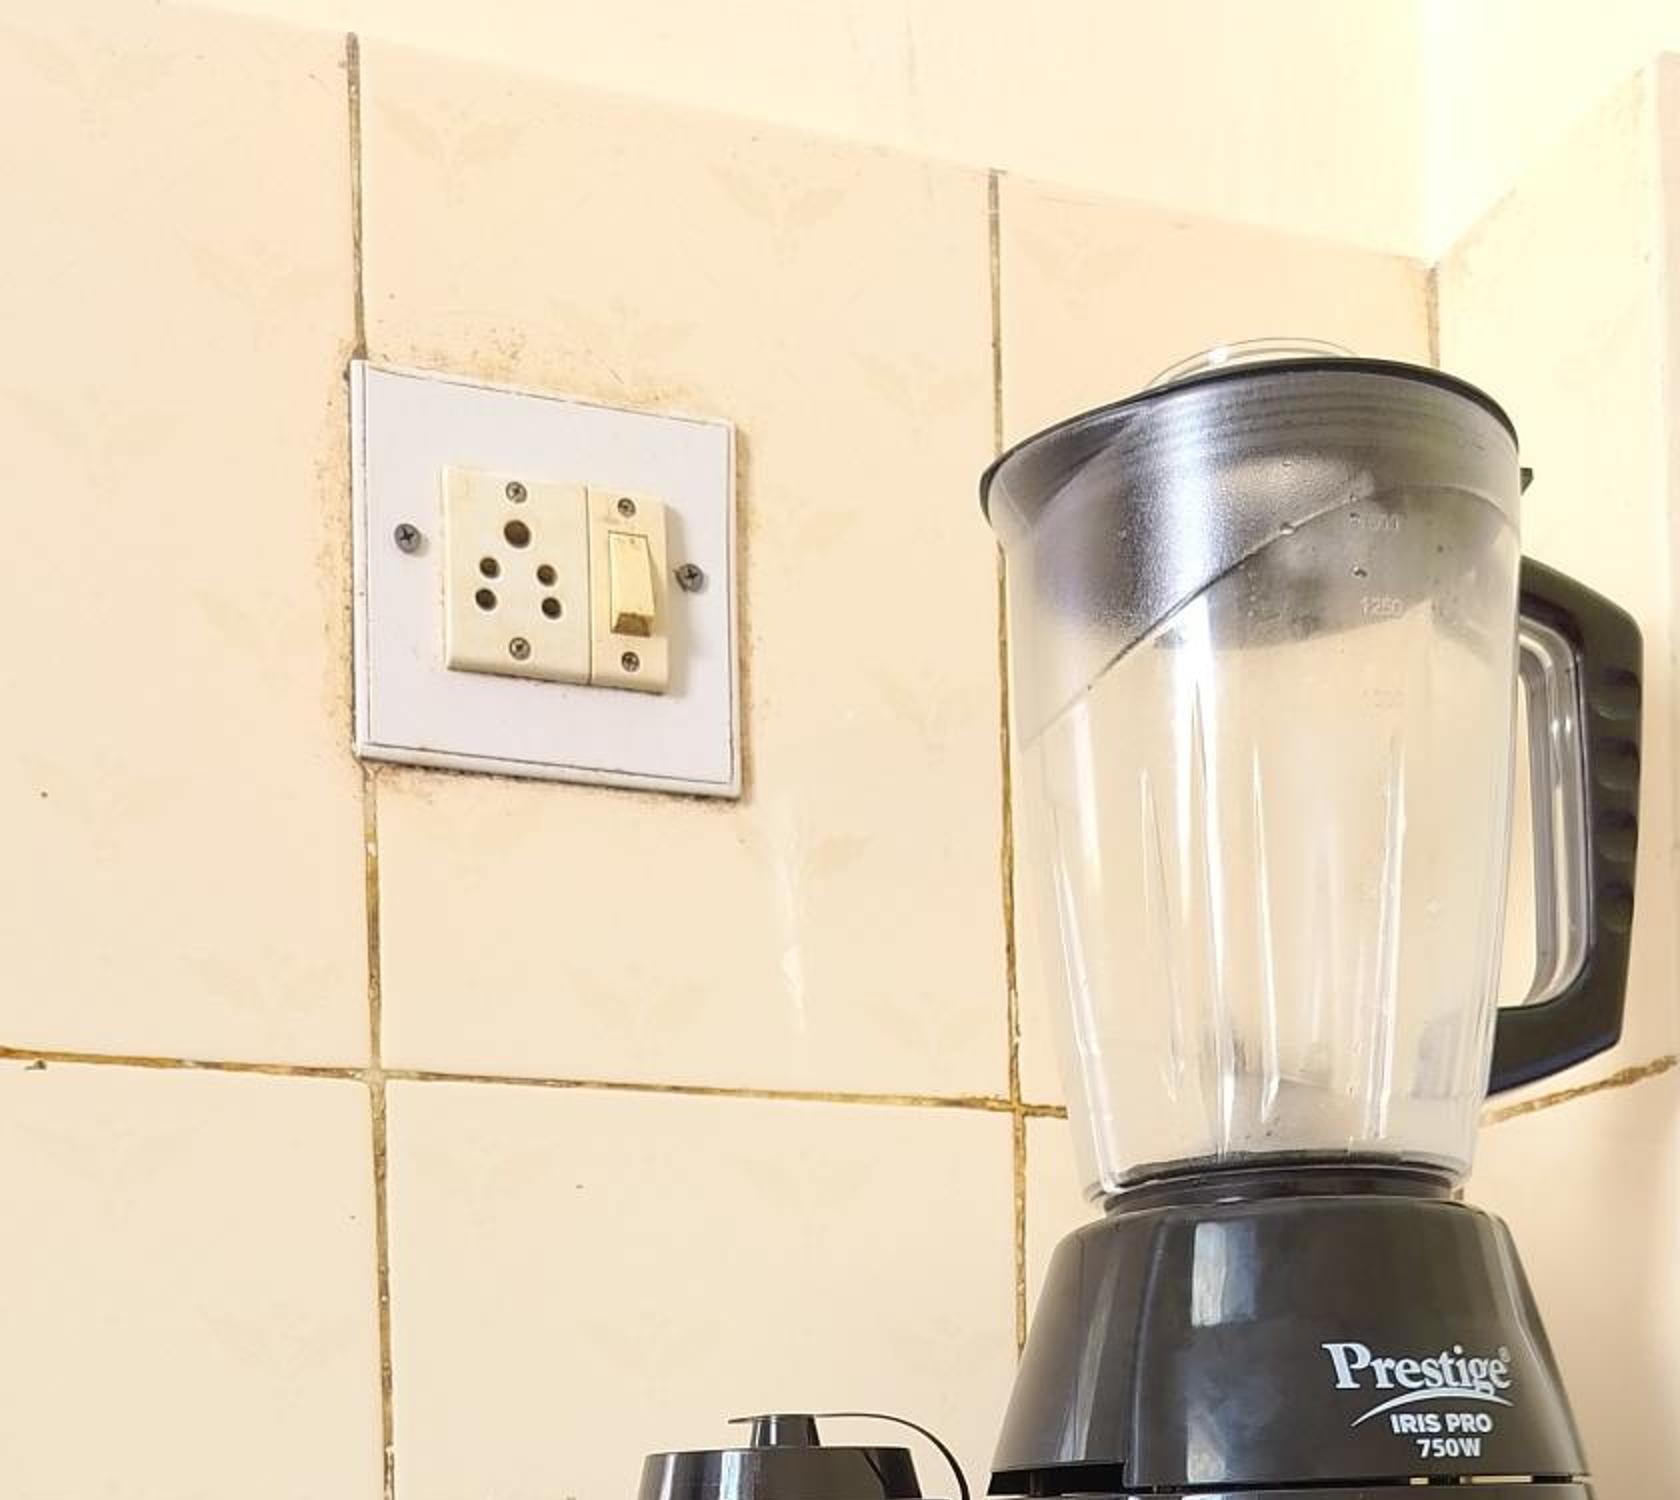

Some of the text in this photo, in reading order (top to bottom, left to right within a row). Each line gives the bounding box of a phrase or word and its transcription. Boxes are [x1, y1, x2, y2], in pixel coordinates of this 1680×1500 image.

[1321, 1342, 1513, 1396] Prestige
[1390, 1413, 1493, 1433] IRIS PRO
[1416, 1438, 1482, 1457] 750W
